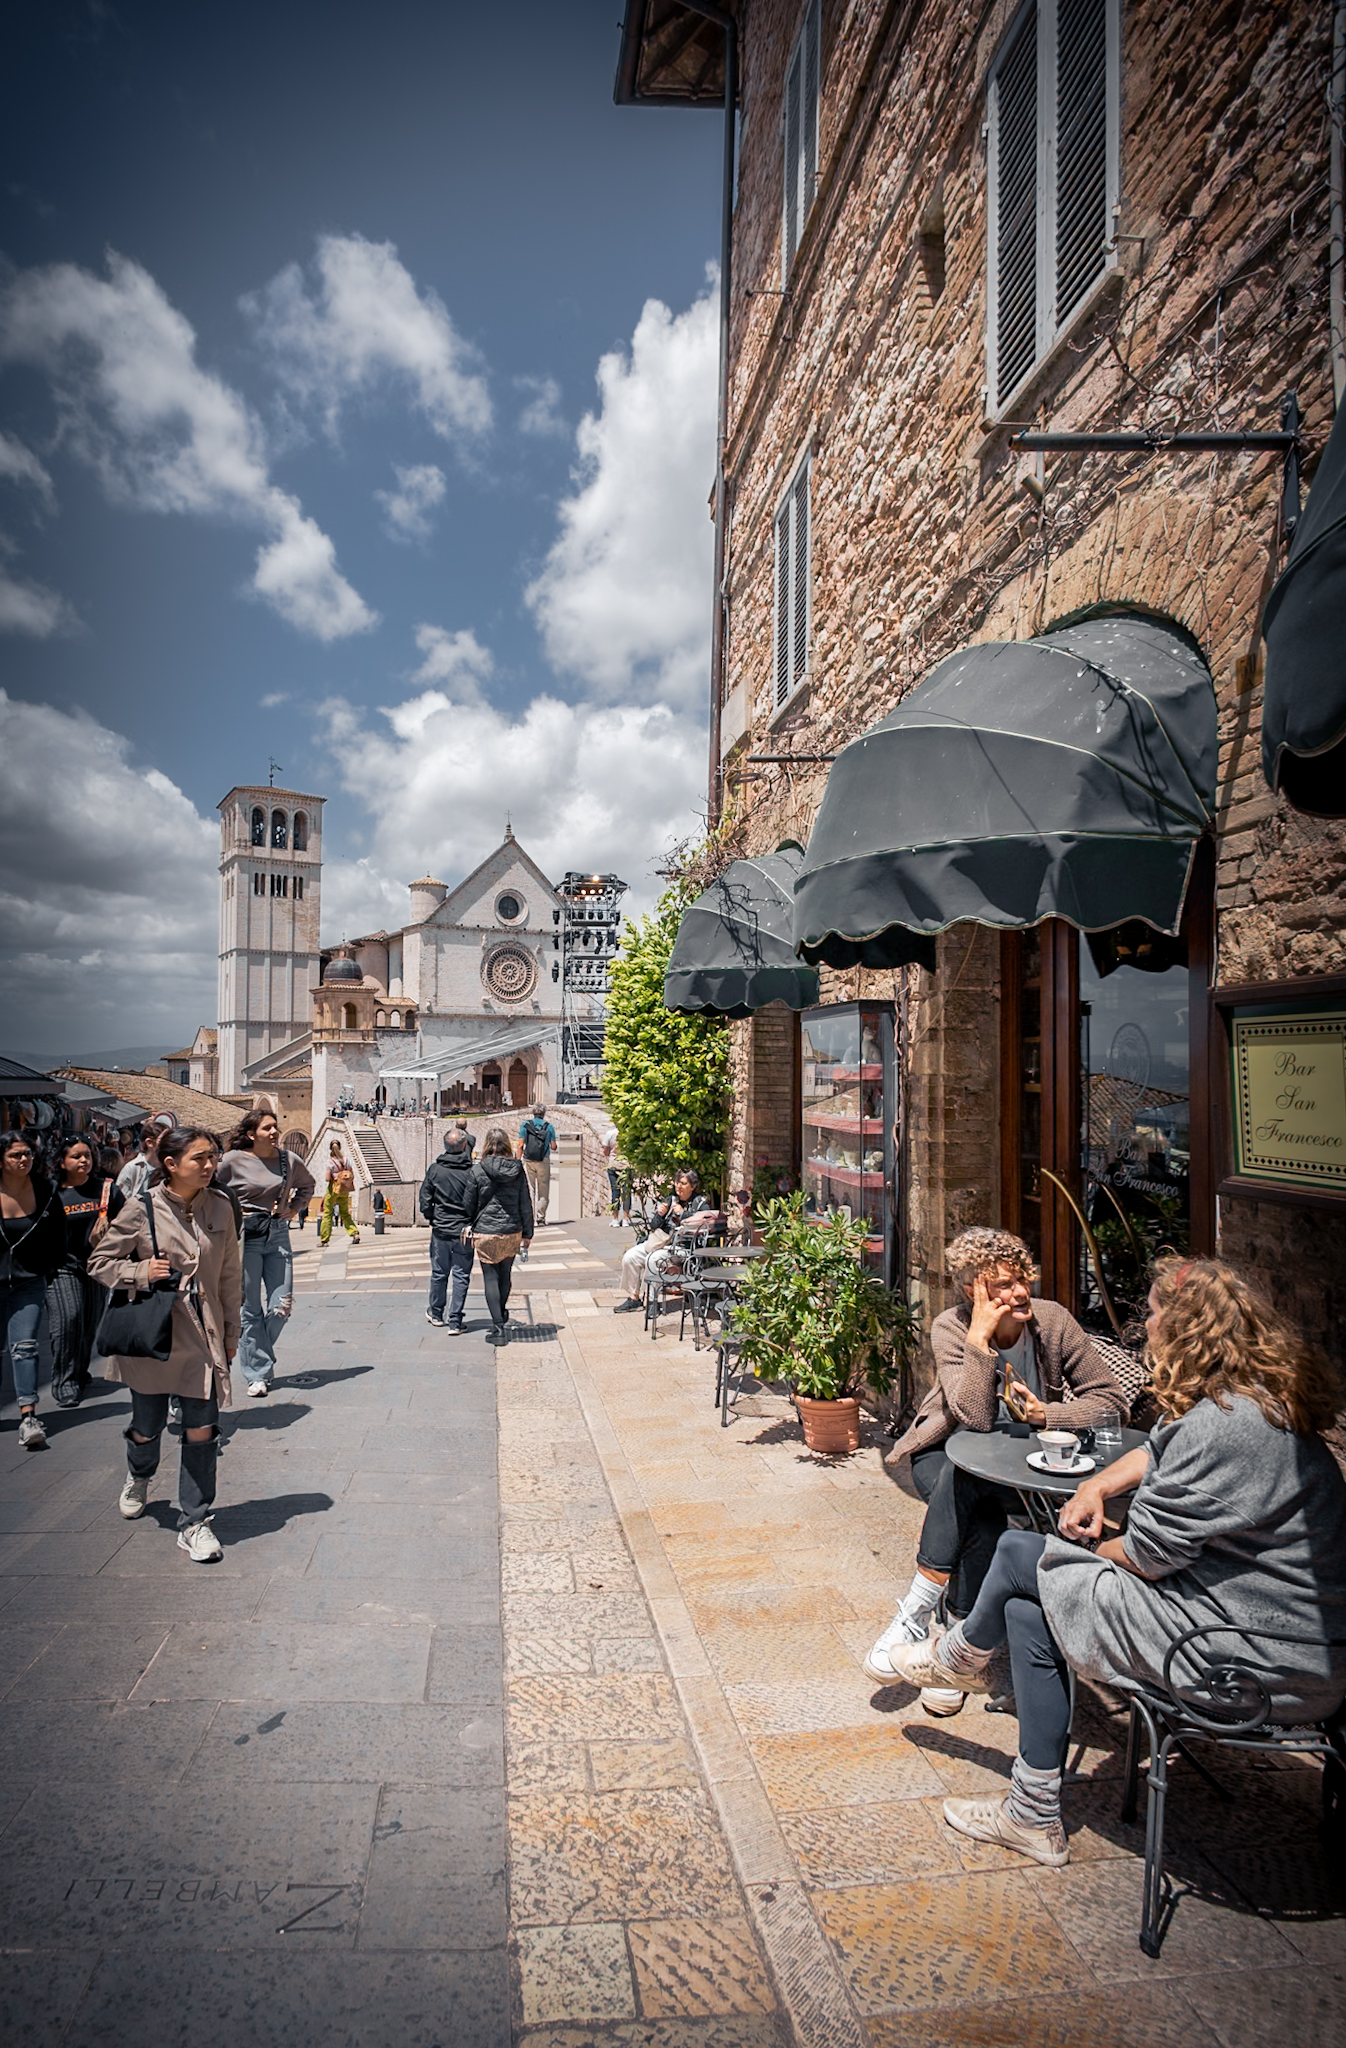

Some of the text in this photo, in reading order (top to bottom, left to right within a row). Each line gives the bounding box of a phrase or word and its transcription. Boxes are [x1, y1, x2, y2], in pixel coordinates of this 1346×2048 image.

[1274, 1051, 1316, 1076] Bar
[1275, 1085, 1317, 1111] San
[1255, 1118, 1344, 1148] Francesco
[1115, 1137, 1144, 1161] Bar
[1087, 1164, 1179, 1197] San Francesco
[64, 1878, 352, 1933] ZAMBELLI
